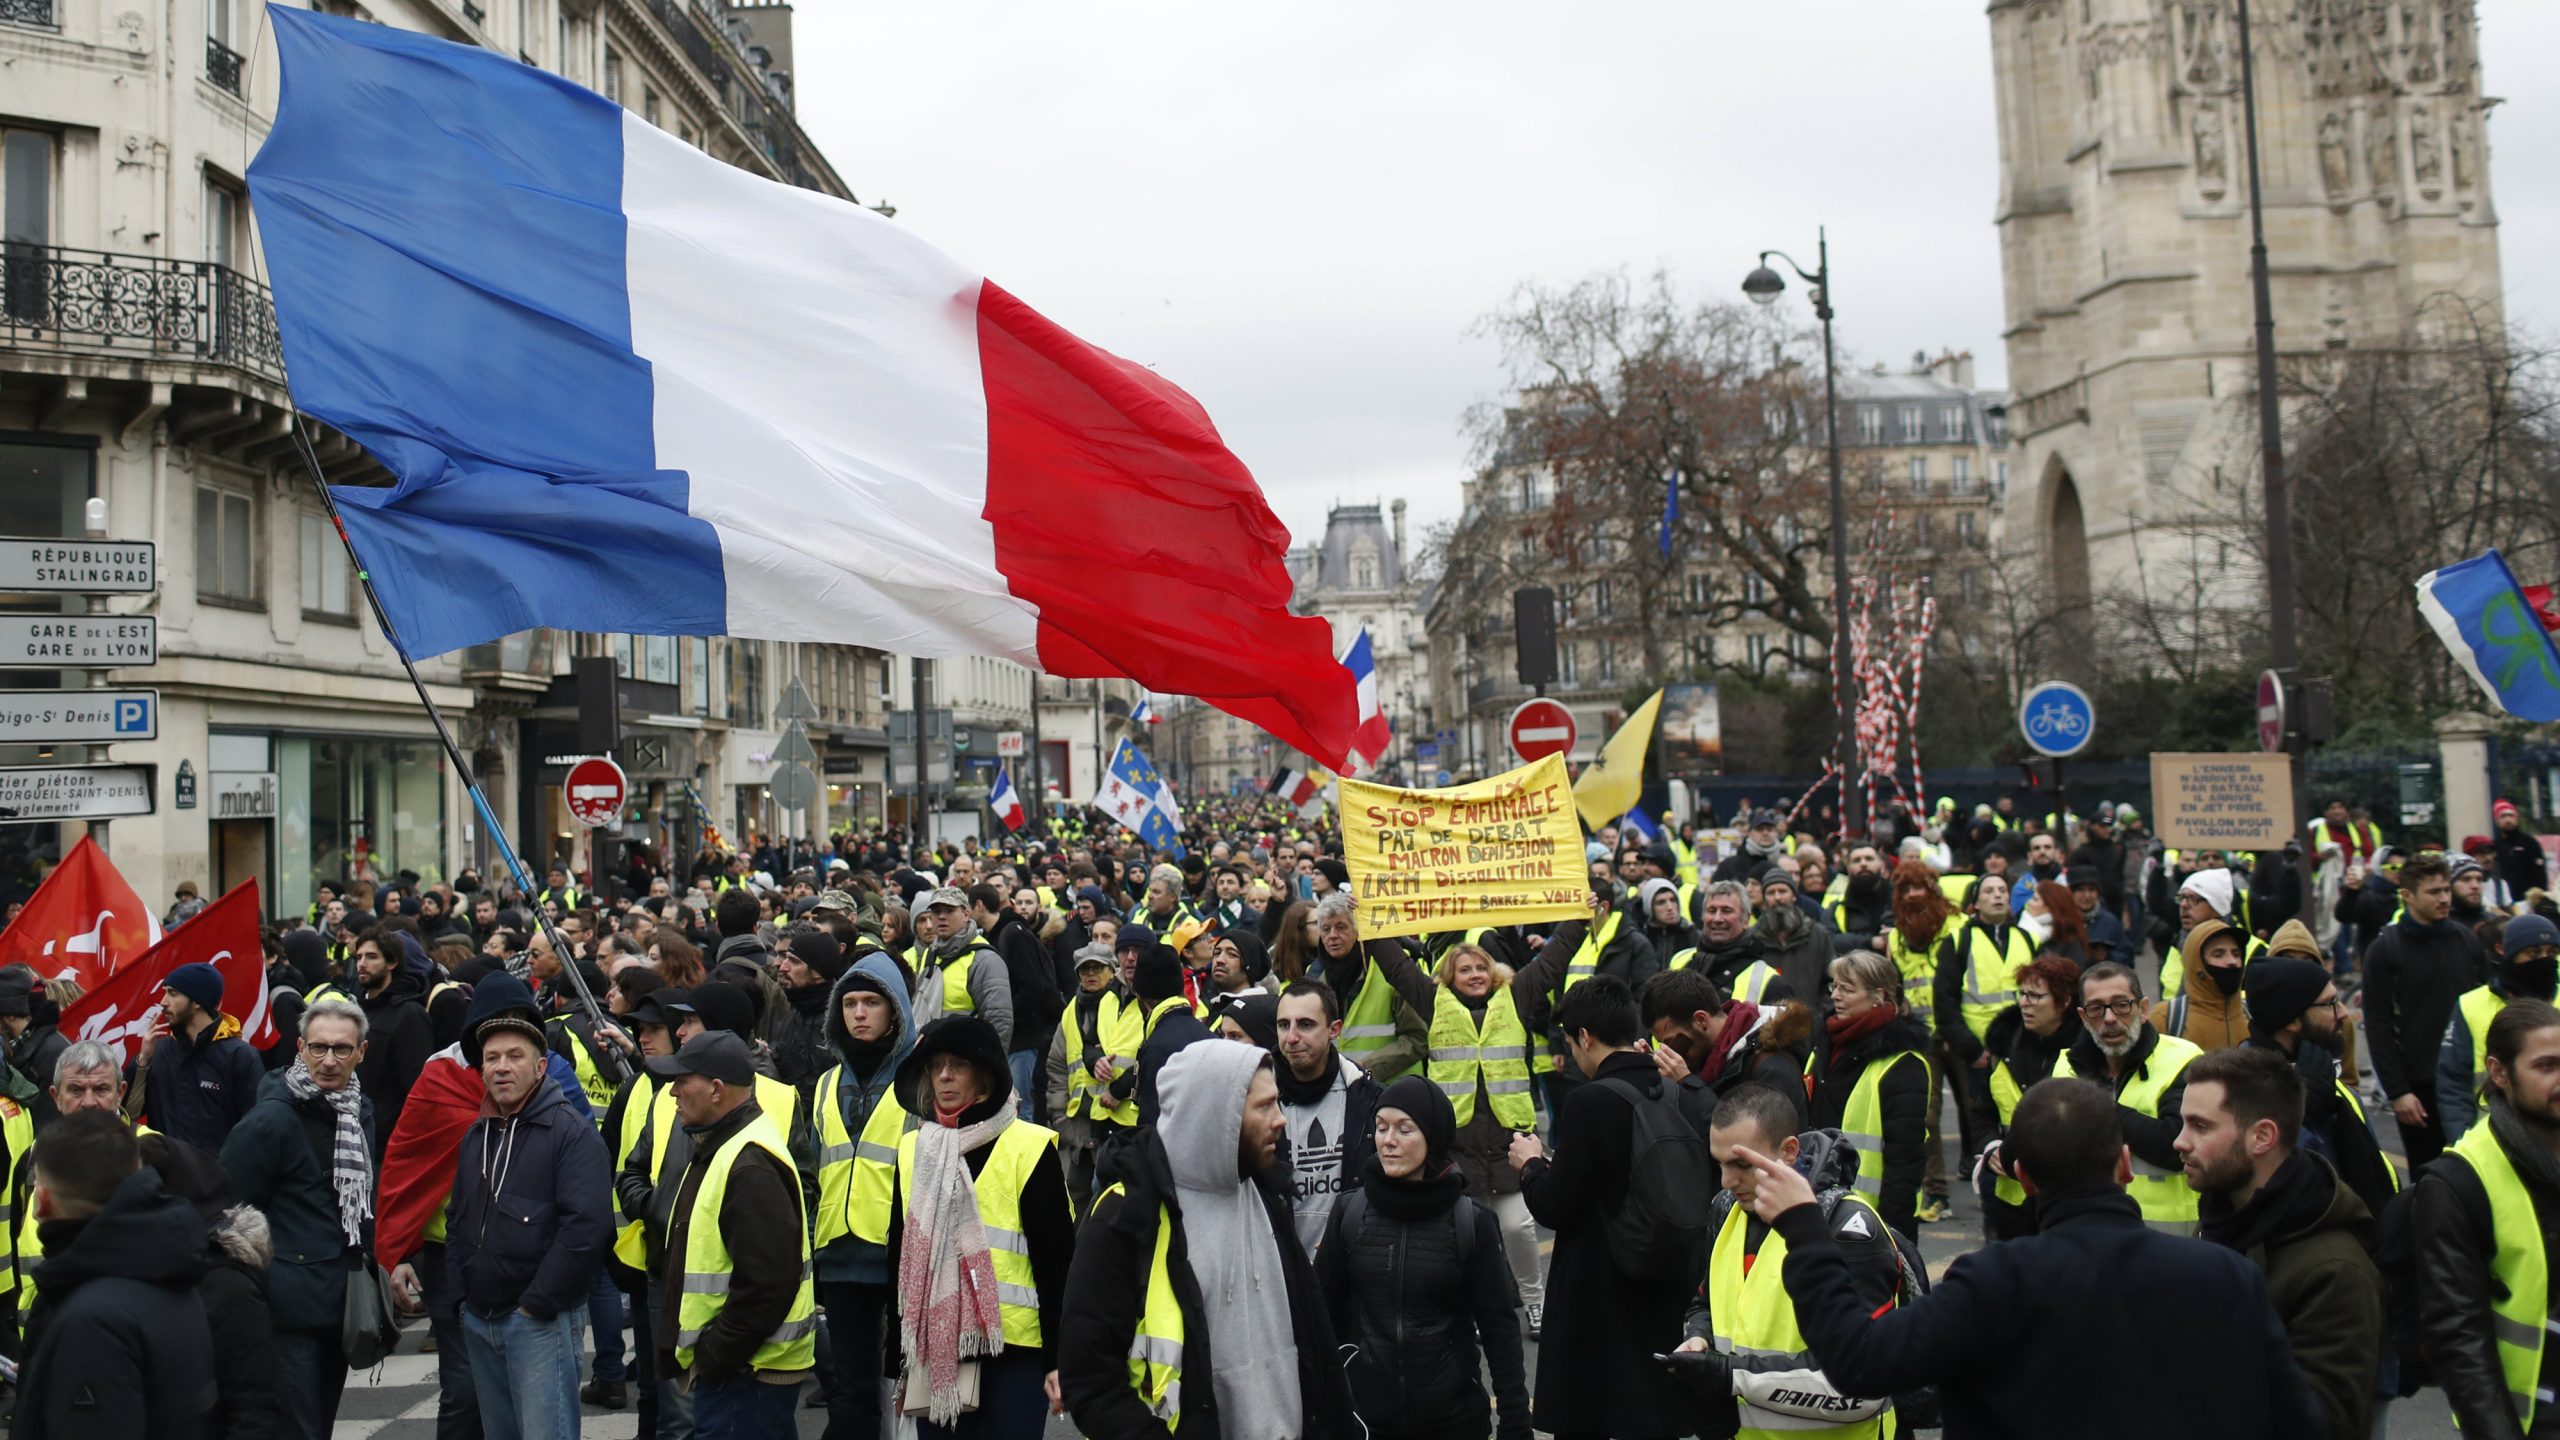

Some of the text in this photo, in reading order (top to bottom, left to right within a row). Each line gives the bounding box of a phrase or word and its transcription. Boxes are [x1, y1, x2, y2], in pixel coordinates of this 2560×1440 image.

[32, 547, 148, 564] RÉPUBLIQUE
[36, 568, 148, 583] STALINGRAD
[31, 625, 149, 638] GARE DE L'EST
[27, 643, 149, 656] GARE DE LYON
[65, 710, 111, 723] Denis
[120, 702, 143, 730] P
[37, 774, 95, 789] piétons
[2240, 774, 2264, 783] PAS
[219, 777, 276, 815] minelli
[1494, 776, 1526, 802] IX
[2182, 784, 2207, 792] PAR
[1366, 783, 1560, 829] STOP ENFUMAGE
[2181, 803, 2197, 812] EN
[2202, 803, 2223, 812] JET
[2175, 817, 2273, 827] PAVILLON POUR
[1429, 829, 1453, 845] DE
[1468, 817, 1548, 845] DEBAT
[1388, 836, 1556, 871] MACRON DEMISSION
[1362, 870, 1421, 899] LREM
[1370, 903, 1400, 933] ÇA
[1479, 894, 1529, 911] BARREZ
